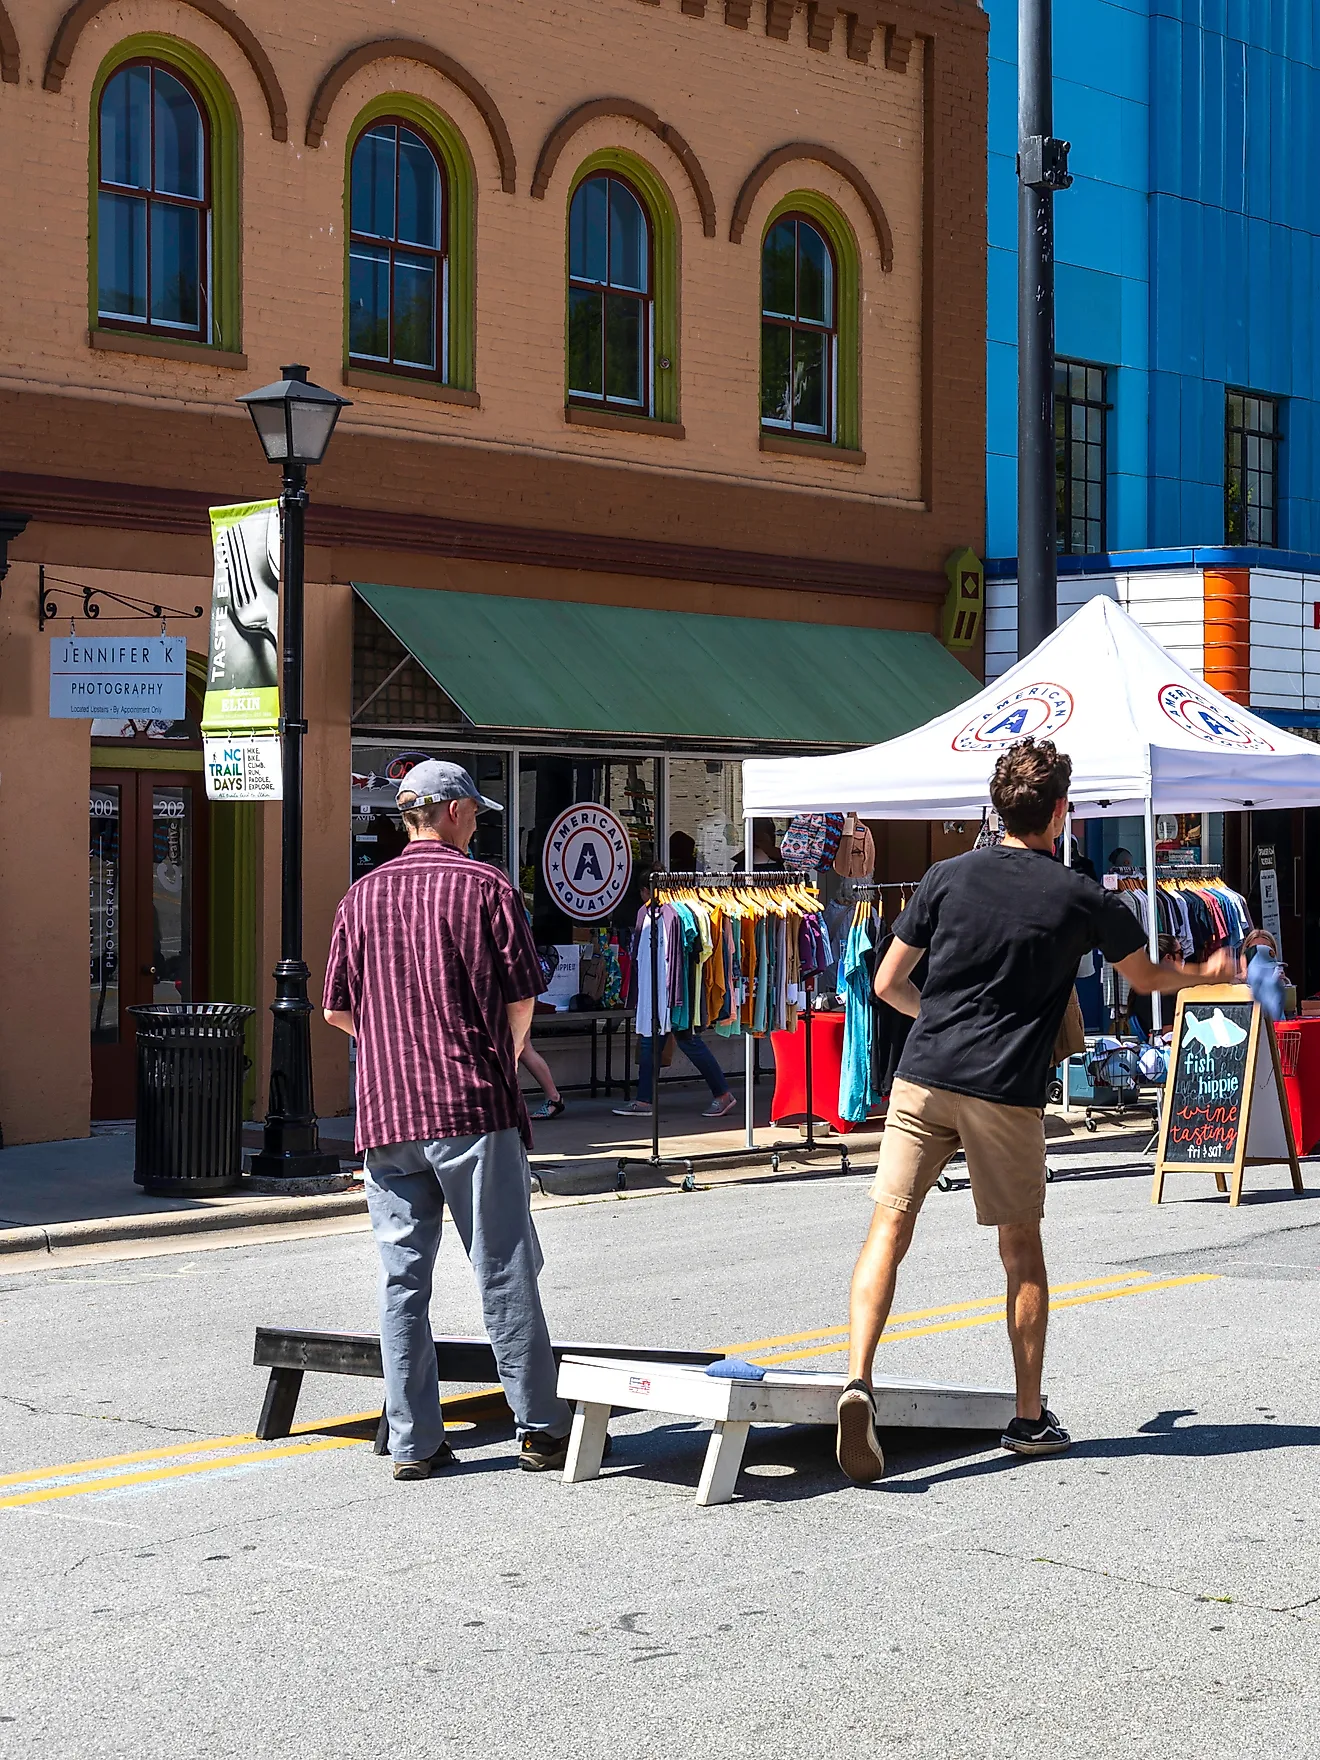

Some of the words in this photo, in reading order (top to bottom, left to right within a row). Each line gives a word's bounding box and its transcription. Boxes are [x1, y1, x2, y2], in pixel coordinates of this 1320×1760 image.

[211, 605, 228, 682] TASTE
[63, 647, 150, 663] JENNIFER
[164, 647, 174, 663] K
[71, 682, 163, 695] PHOTOGRAPHY
[70, 705, 90, 713] Located
[90, 705, 109, 714] Upstairs
[113, 706, 119, 714] By
[120, 705, 150, 715] Appointment
[151, 705, 162, 714] Only
[221, 697, 260, 713] ELKIN
[224, 749, 242, 762] NC
[209, 764, 242, 777] TRAIL
[214, 778, 242, 791] DAYS
[158, 801, 186, 817] 202
[553, 813, 624, 852] AMERICAN
[555, 880, 620, 911] AQUATIC
[106, 859, 115, 968] PHOTOGRAPHY
[1184, 1052, 1214, 1075] fish
[1199, 1072, 1239, 1100] hippie
[1176, 1104, 1237, 1124] wine
[1170, 1123, 1238, 1151] tasting
[1187, 1144, 1201, 1159] fri
[1208, 1142, 1223, 1158] sat
